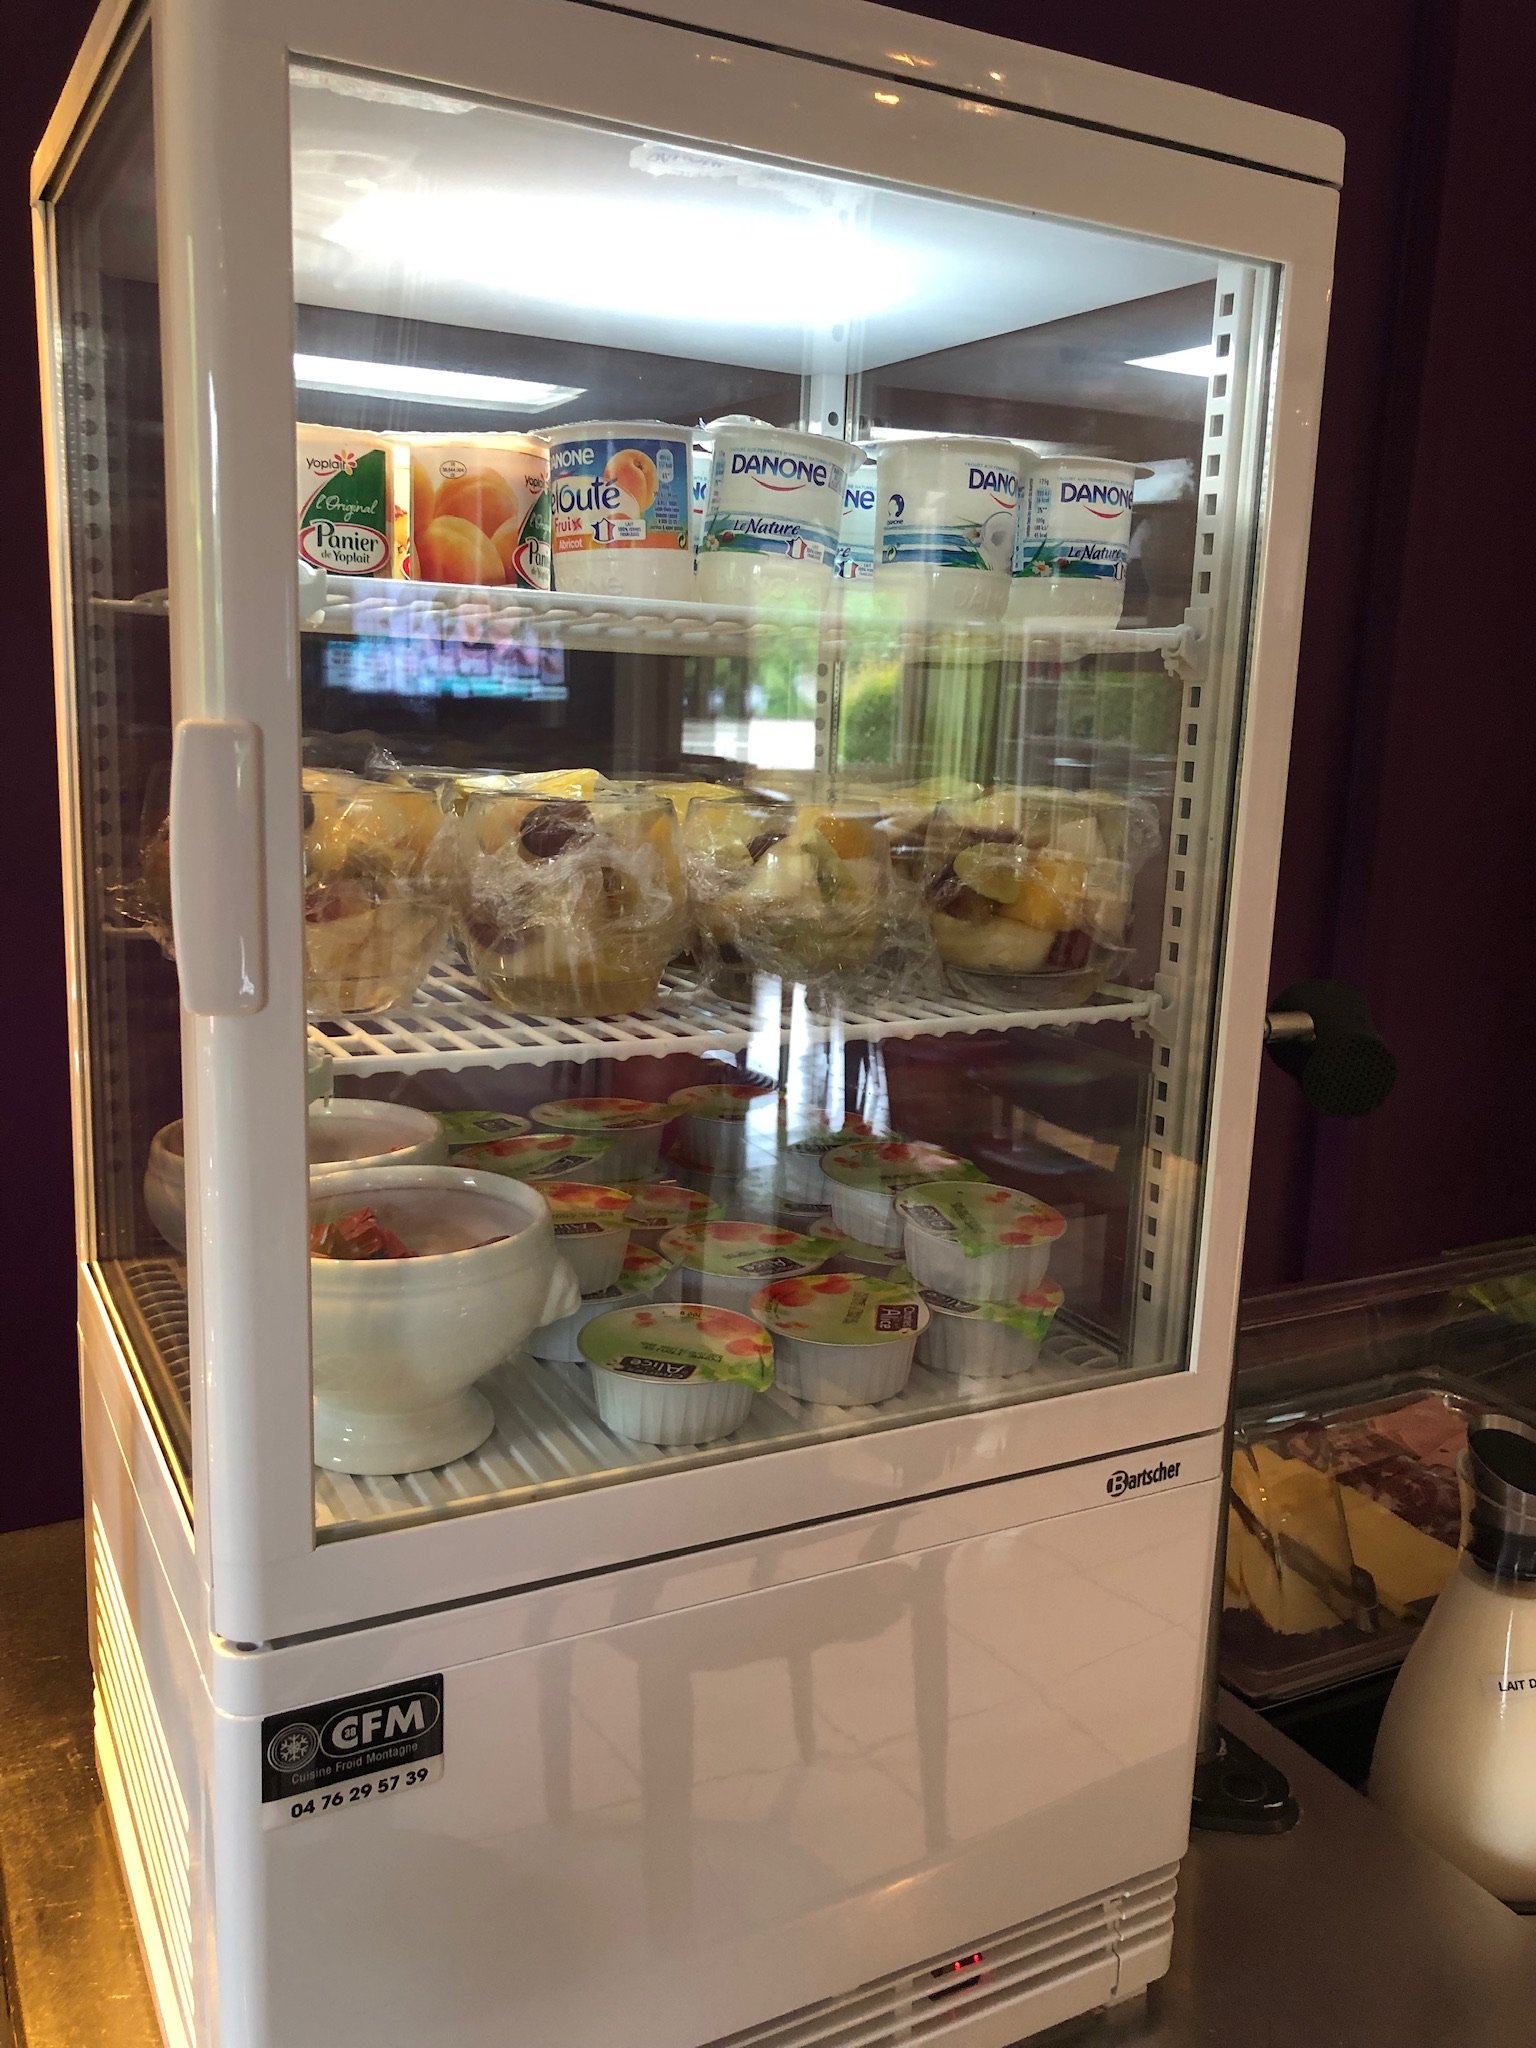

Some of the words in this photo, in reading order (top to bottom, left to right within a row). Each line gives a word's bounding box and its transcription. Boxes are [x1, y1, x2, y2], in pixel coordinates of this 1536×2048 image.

[316, 520, 379, 552] Panier
[744, 518, 800, 536] Nature
[333, 550, 370, 564] Yoplait
[629, 1358, 687, 1375] Alice
[1106, 1461, 1181, 1497] Bartscher
[1498, 1679, 1526, 1692] LAIT
[291, 1765, 332, 1785] Cuisine
[335, 1757, 363, 1772] Froid
[366, 1742, 418, 1763] Montagne
[291, 1800, 316, 1818] 04
[321, 1792, 344, 1809] 76
[349, 1784, 373, 1801] 29
[378, 1775, 400, 1793] 57
[405, 1768, 429, 1785] 39
